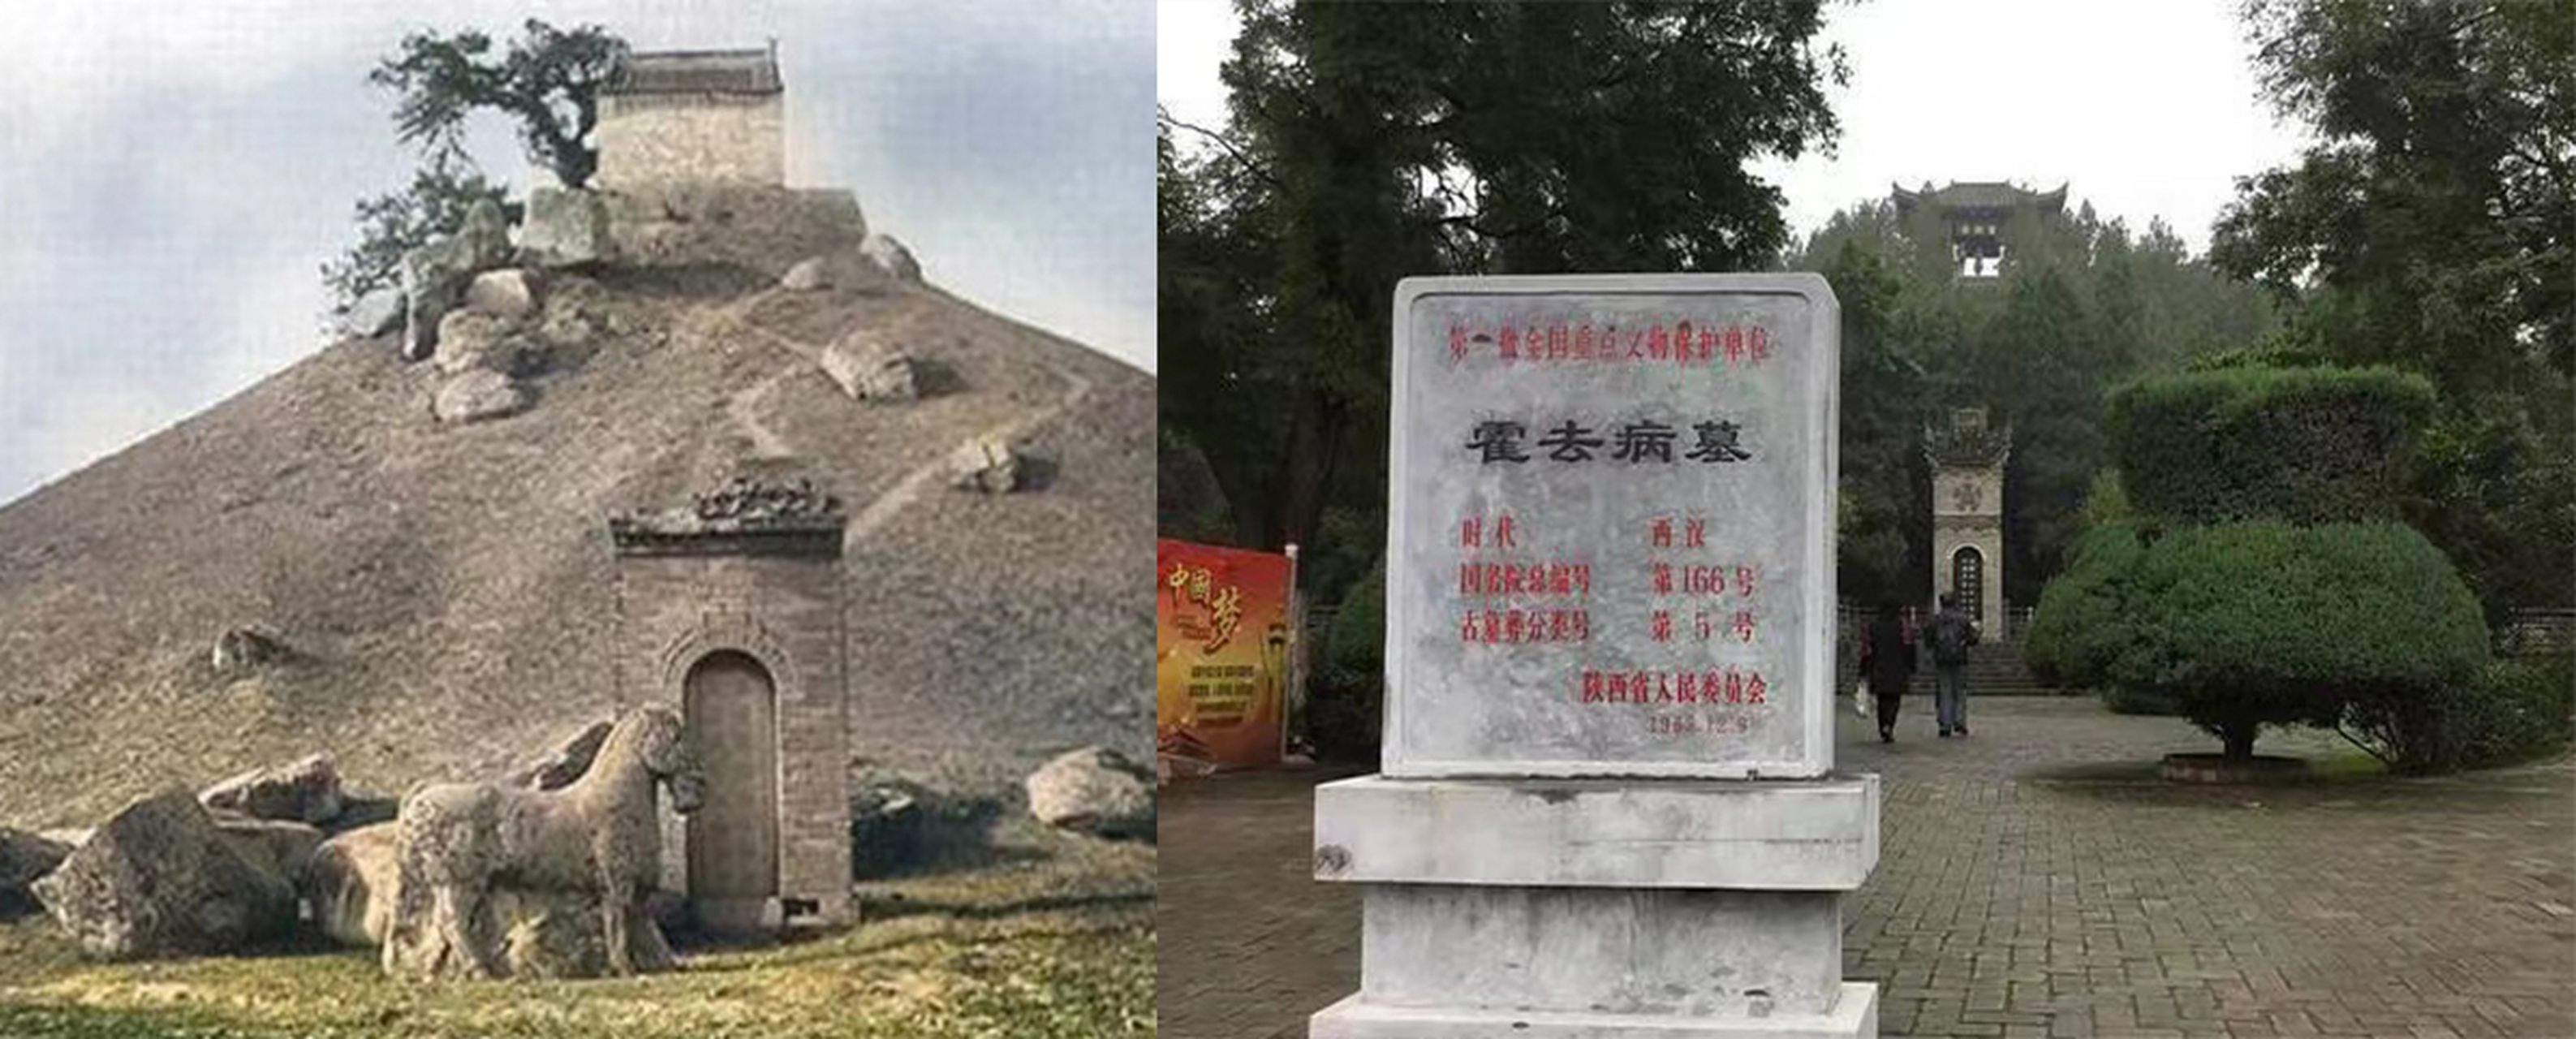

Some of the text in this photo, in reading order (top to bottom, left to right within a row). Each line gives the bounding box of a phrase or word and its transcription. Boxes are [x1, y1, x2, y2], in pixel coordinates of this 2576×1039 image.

[1466, 420, 1751, 463] 霍去病墓
[1462, 515, 1705, 548] 时代 西汉
[1170, 563, 1241, 650] 中国梦
[1583, 670, 1767, 704] 陕西省人民委员会
